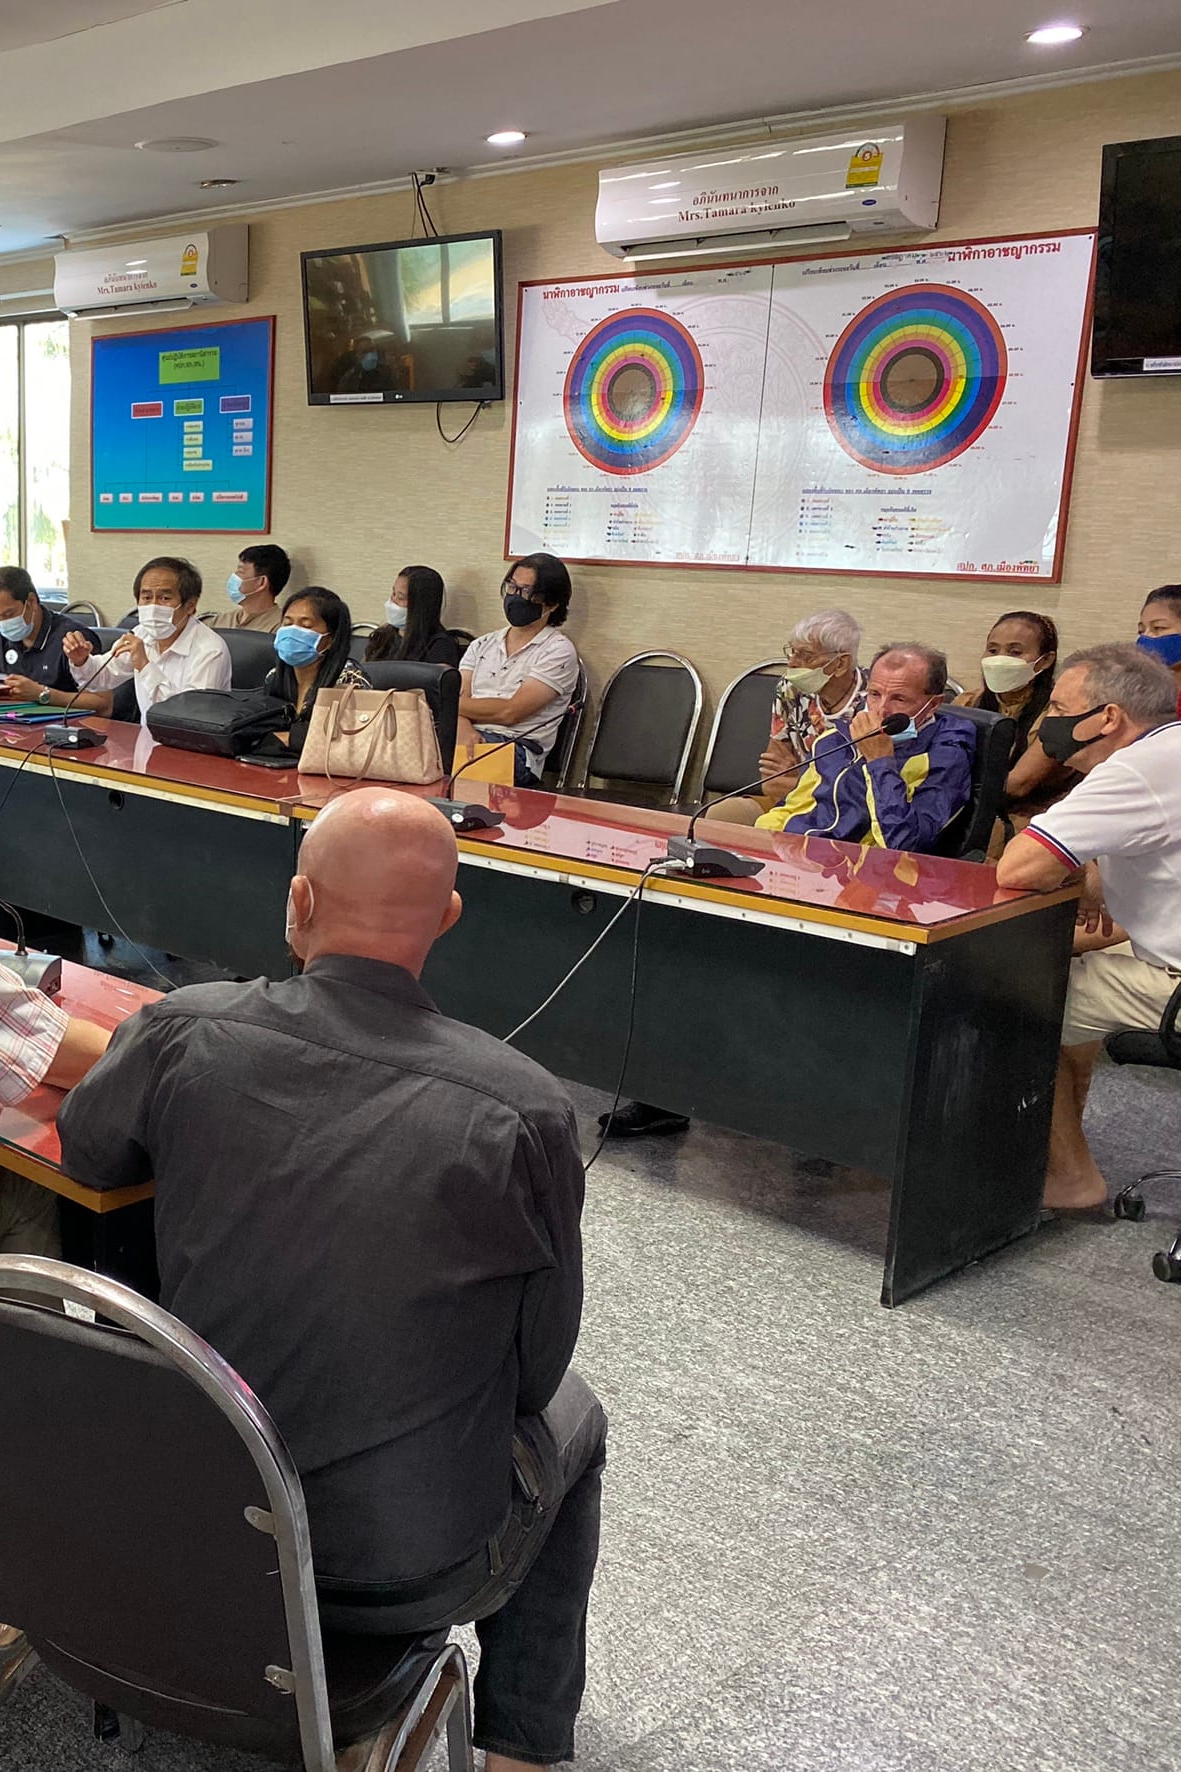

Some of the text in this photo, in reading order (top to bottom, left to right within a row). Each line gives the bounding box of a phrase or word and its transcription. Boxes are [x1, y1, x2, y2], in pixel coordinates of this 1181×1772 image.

[693, 185, 779, 206] อภินันทนาการจาก
[948, 242, 1061, 262] นาฬิกาอาชญากรรม
[543, 285, 620, 299] นาฬิกาอาชญากรรม
